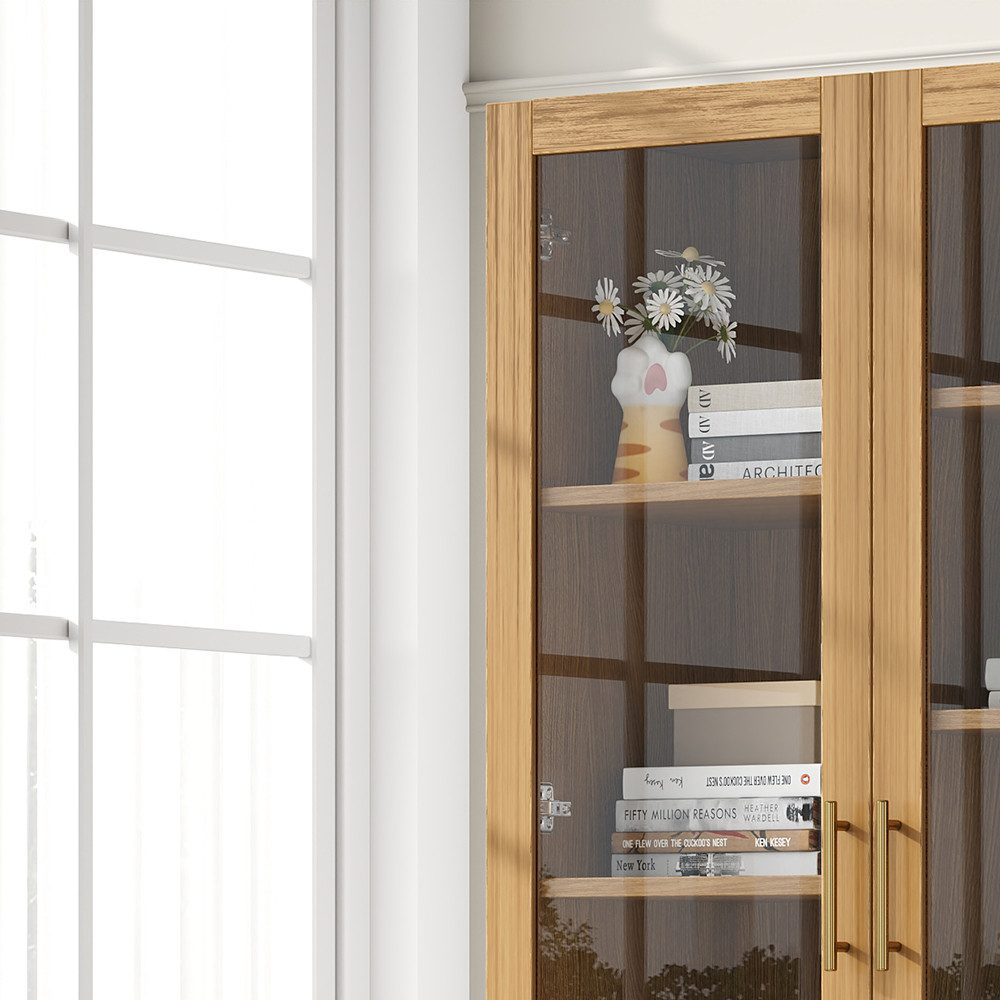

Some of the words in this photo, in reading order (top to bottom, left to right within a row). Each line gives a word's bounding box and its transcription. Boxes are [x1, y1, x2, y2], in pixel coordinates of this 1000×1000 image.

[706, 776, 718, 787] NEST
[743, 776, 753, 786] THE
[754, 775, 766, 786] OVER
[767, 775, 781, 785] FLEW
[781, 775, 792, 785] ONE
[744, 804, 779, 813] HEATHER
[624, 810, 647, 821] FIFTY
[652, 808, 689, 820] MILLION
[693, 808, 737, 820] REASONS
[743, 813, 779, 822] WARDELL
[622, 839, 634, 848] ONE
[635, 839, 651, 848] FLEW
[654, 839, 668, 848] OVER
[672, 839, 682, 848] THE
[683, 838, 711, 848] CUCKOO'S
[712, 838, 728, 847] NEST
[754, 838, 768, 847] KEN
[770, 838, 791, 847] KESEY
[616, 860, 634, 871] New
[636, 859, 656, 870] York
